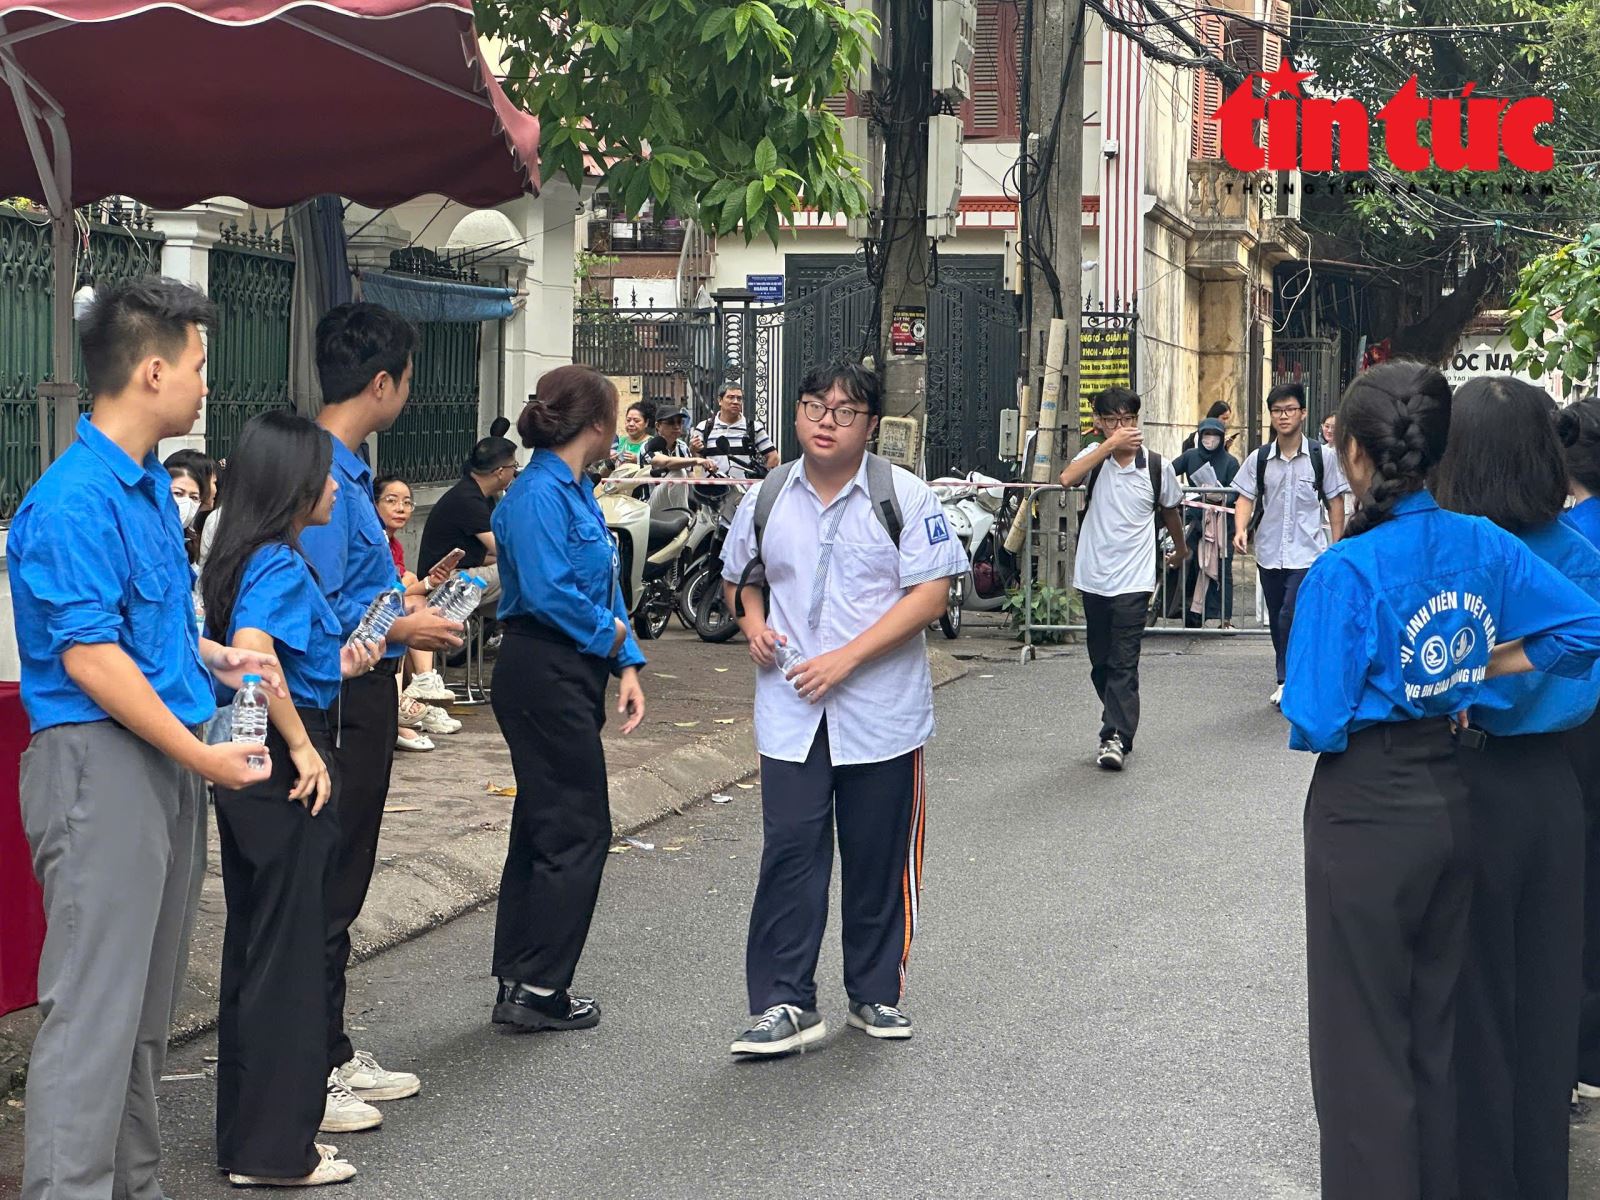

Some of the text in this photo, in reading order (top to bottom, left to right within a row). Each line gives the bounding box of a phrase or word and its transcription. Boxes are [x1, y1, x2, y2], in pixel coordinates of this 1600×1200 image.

[1485, 353, 1525, 372] NA
[1428, 589, 1458, 616] VIÊN
[1463, 592, 1488, 620] VIỆT
